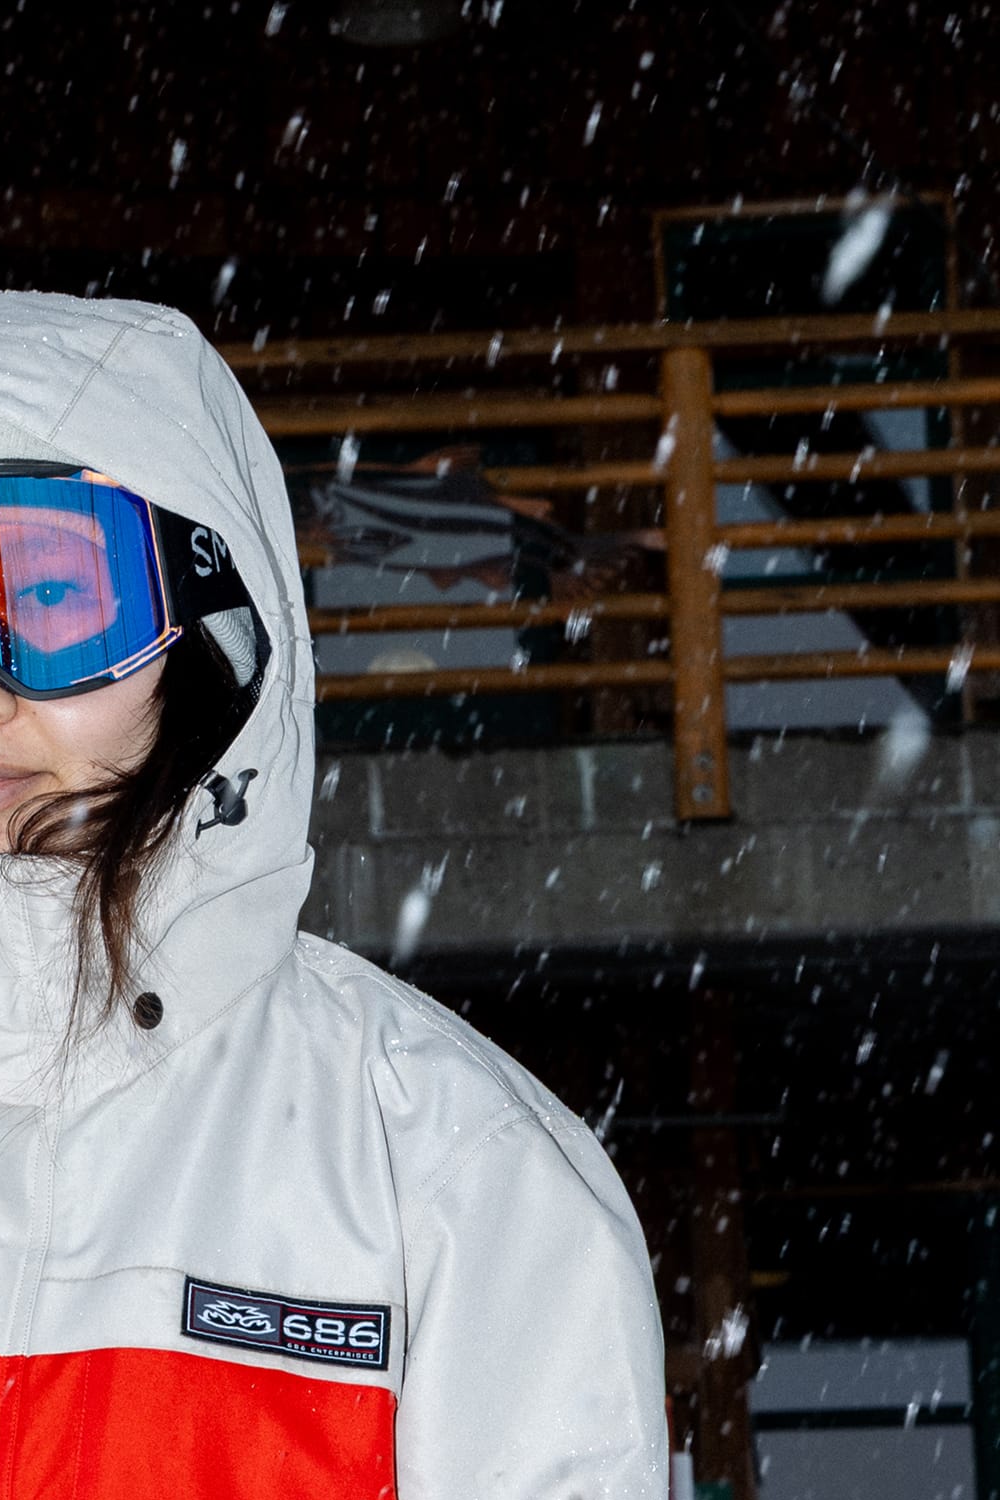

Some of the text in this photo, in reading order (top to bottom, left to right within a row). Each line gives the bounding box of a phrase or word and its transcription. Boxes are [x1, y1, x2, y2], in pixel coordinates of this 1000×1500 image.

[282, 1314, 381, 1348] 686
[286, 1342, 374, 1360] 686 ENTERPRISES
